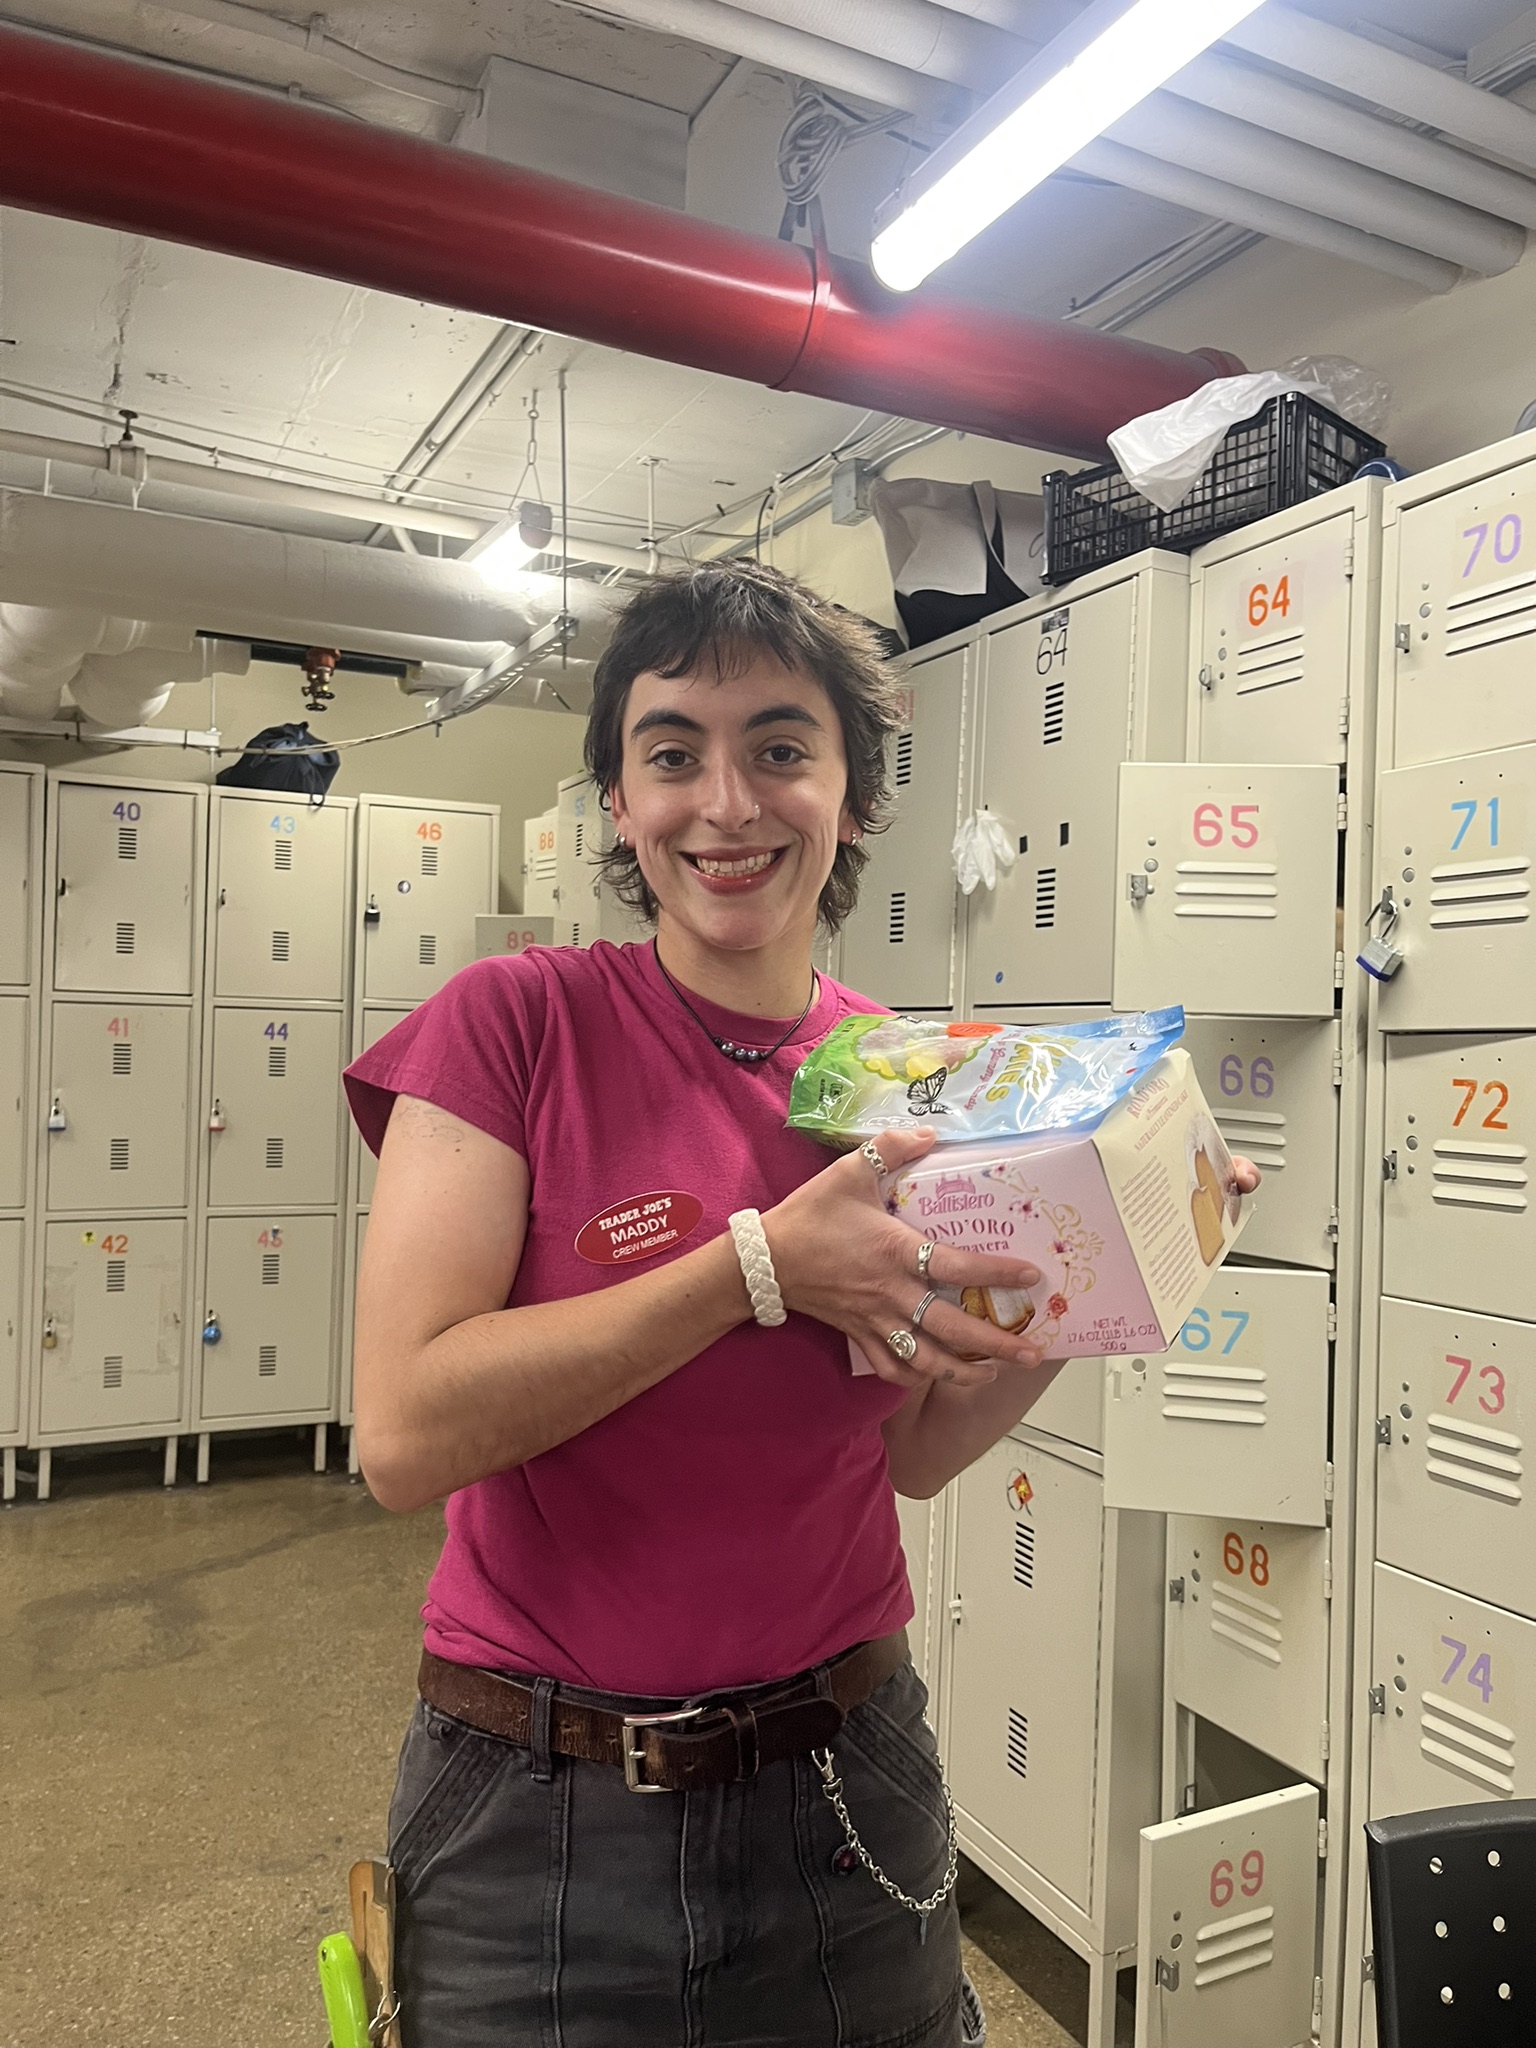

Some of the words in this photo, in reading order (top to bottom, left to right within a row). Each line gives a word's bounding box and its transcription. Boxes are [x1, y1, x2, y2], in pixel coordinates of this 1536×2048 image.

[1463, 513, 1523, 578] 70
[1249, 575, 1291, 627] 64
[1036, 628, 1068, 675] 64
[112, 802, 141, 822] 40
[269, 816, 296, 834] 43
[1192, 803, 1260, 849] 65
[1450, 797, 1501, 851] 71
[416, 822, 443, 842] 46
[539, 831, 555, 851] 88
[506, 930, 535, 949] 89
[107, 1017, 130, 1038] 41
[263, 1022, 290, 1042] 44
[1219, 1055, 1275, 1099] 66
[1452, 1078, 1510, 1131] 72
[598, 1208, 641, 1231] TRADER
[642, 1197, 672, 1215] JOE'S
[610, 1214, 668, 1245] MADDY
[924, 1218, 1015, 1241] OND'ORO
[101, 1234, 129, 1254] 42
[612, 1241, 640, 1259] CREW
[640, 1229, 679, 1249] MEMBER
[1093, 1318, 1110, 1329] NET
[1181, 1308, 1250, 1355] 67
[1445, 1354, 1508, 1415] 73
[1223, 1532, 1271, 1588] 68
[1440, 1636, 1494, 1704] 74
[1210, 1850, 1266, 1908] 69
